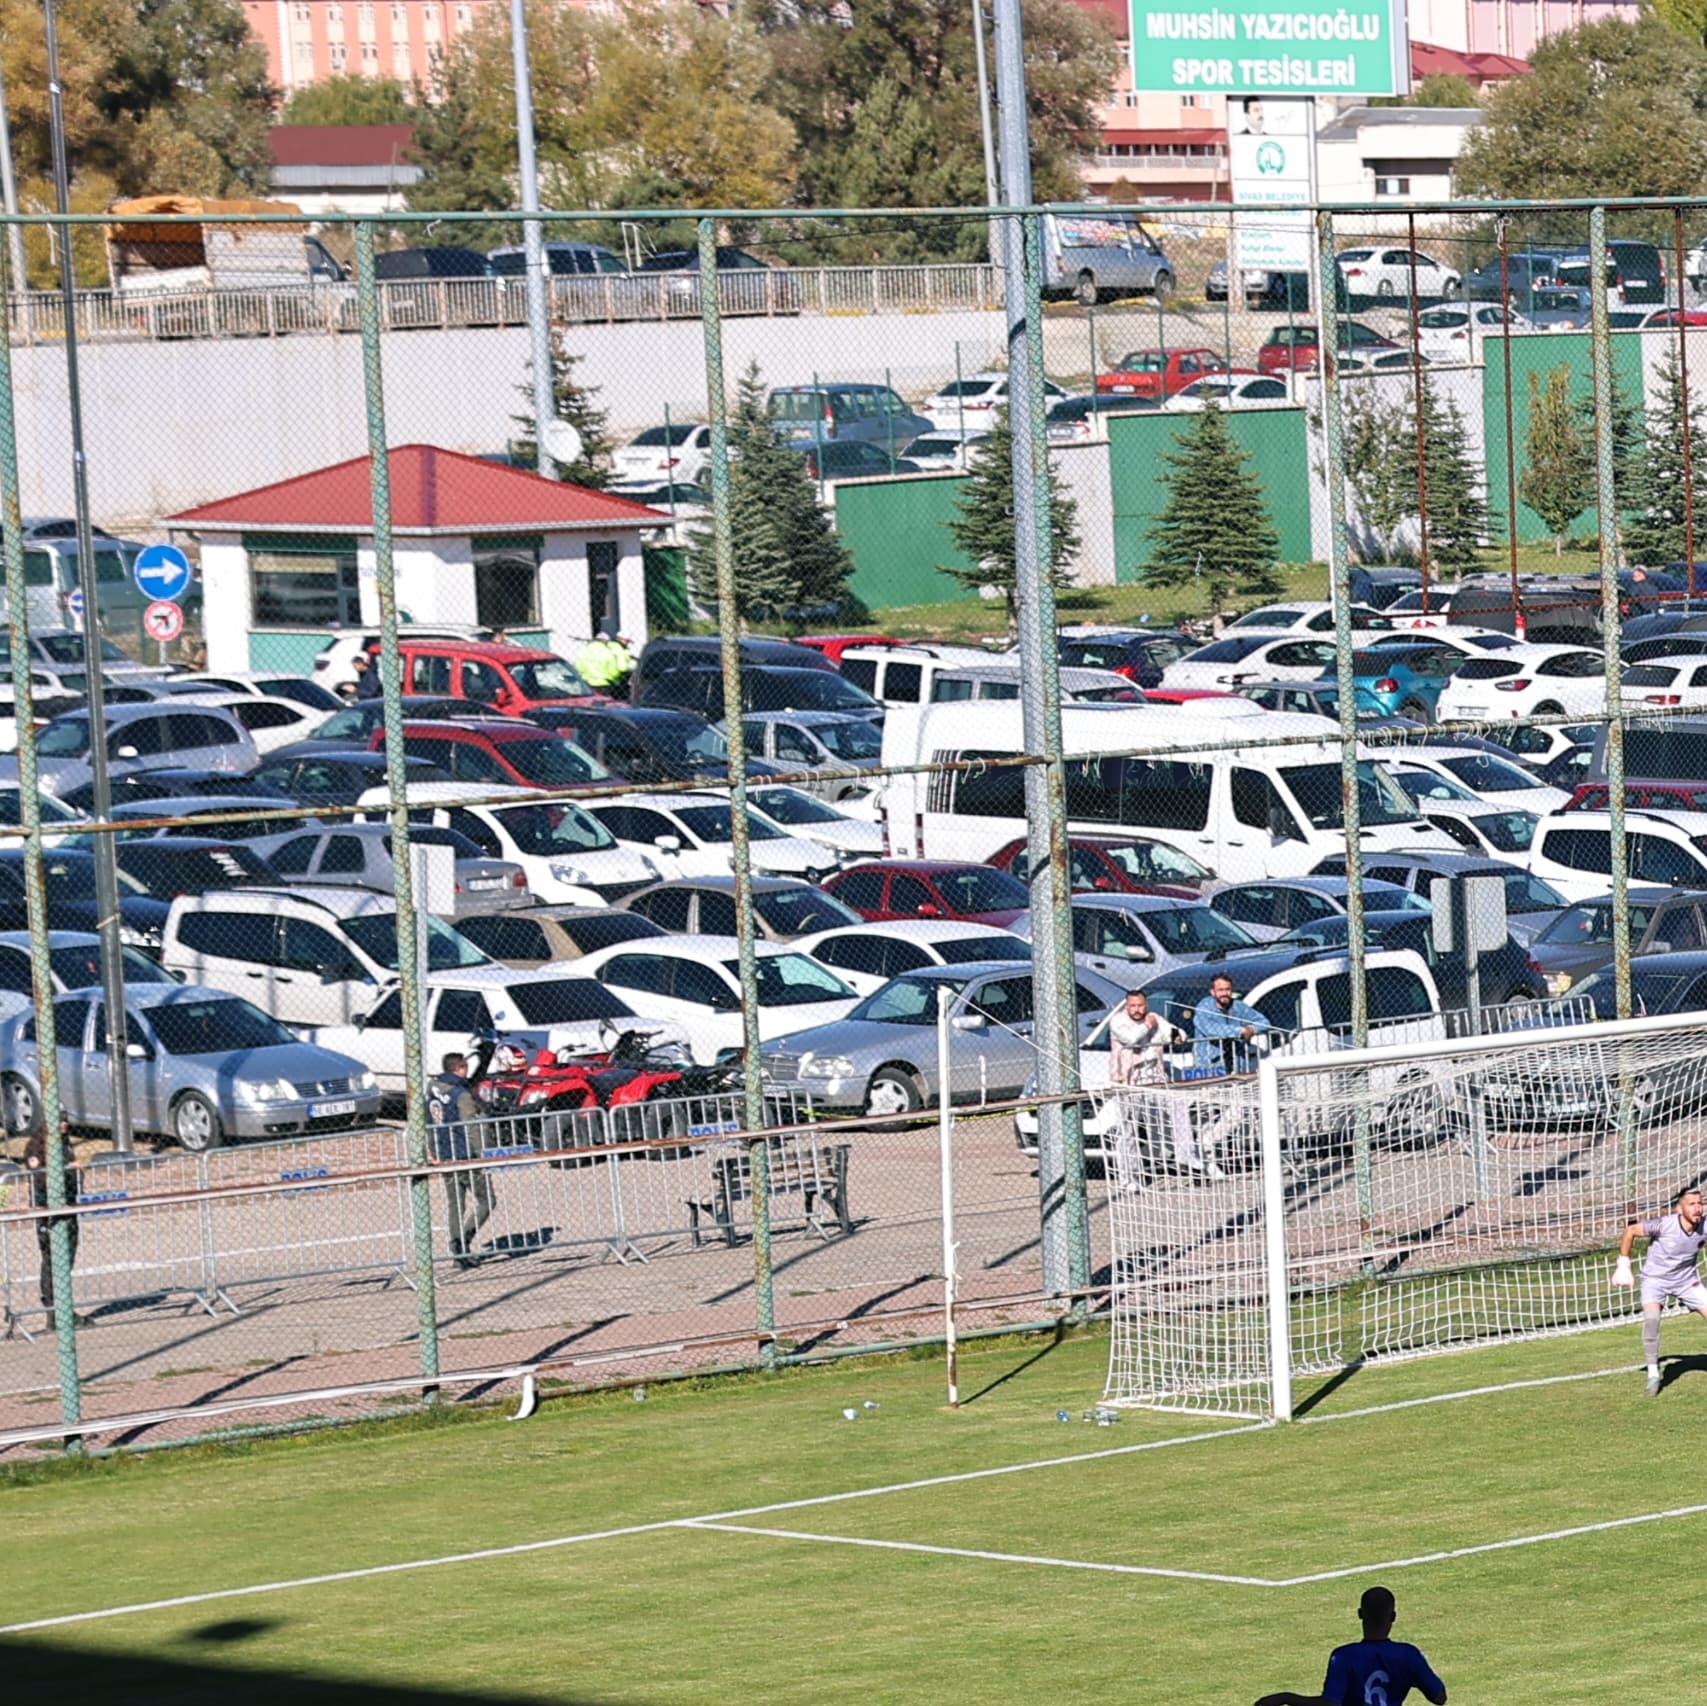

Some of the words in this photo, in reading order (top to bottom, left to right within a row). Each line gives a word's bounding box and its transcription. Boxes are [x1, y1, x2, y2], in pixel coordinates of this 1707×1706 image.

[1146, 8, 1235, 40] MUHSİN
[1240, 8, 1380, 41] YAZICIOĞLU
[1172, 58, 1234, 86] SPOR
[1238, 54, 1356, 86] TESİSLERİ
